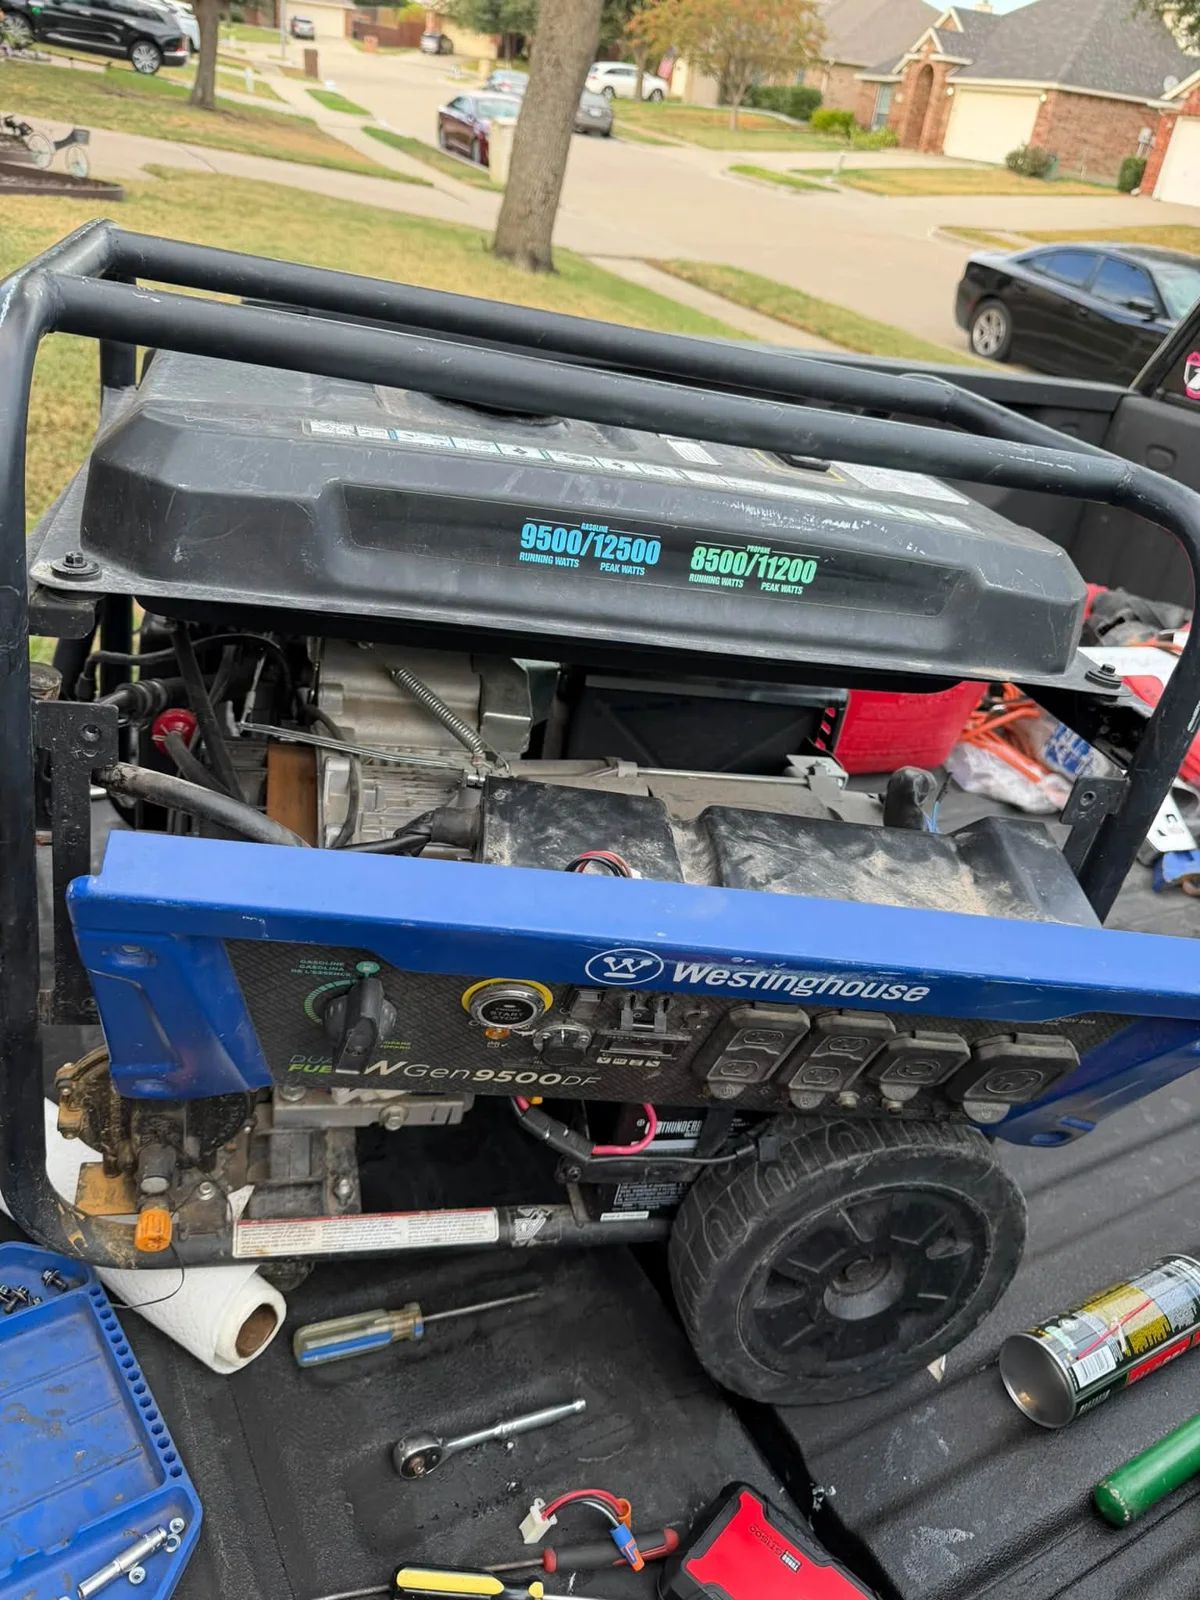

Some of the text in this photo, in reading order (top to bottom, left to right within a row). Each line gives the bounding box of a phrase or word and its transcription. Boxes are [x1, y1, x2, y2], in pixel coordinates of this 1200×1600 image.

[580, 522, 610, 534] GASOLINE
[519, 522, 662, 566] 9500/12500
[746, 544, 772, 555] PROPANE
[519, 551, 580, 569] RUNNING WATTS
[690, 546, 818, 585] 8500/11200
[599, 562, 646, 576] PEAK WATTS
[688, 573, 745, 588] RUNNING WATTS
[760, 581, 804, 595] PEAK WATTS
[671, 961, 931, 1002] Westinghouse
